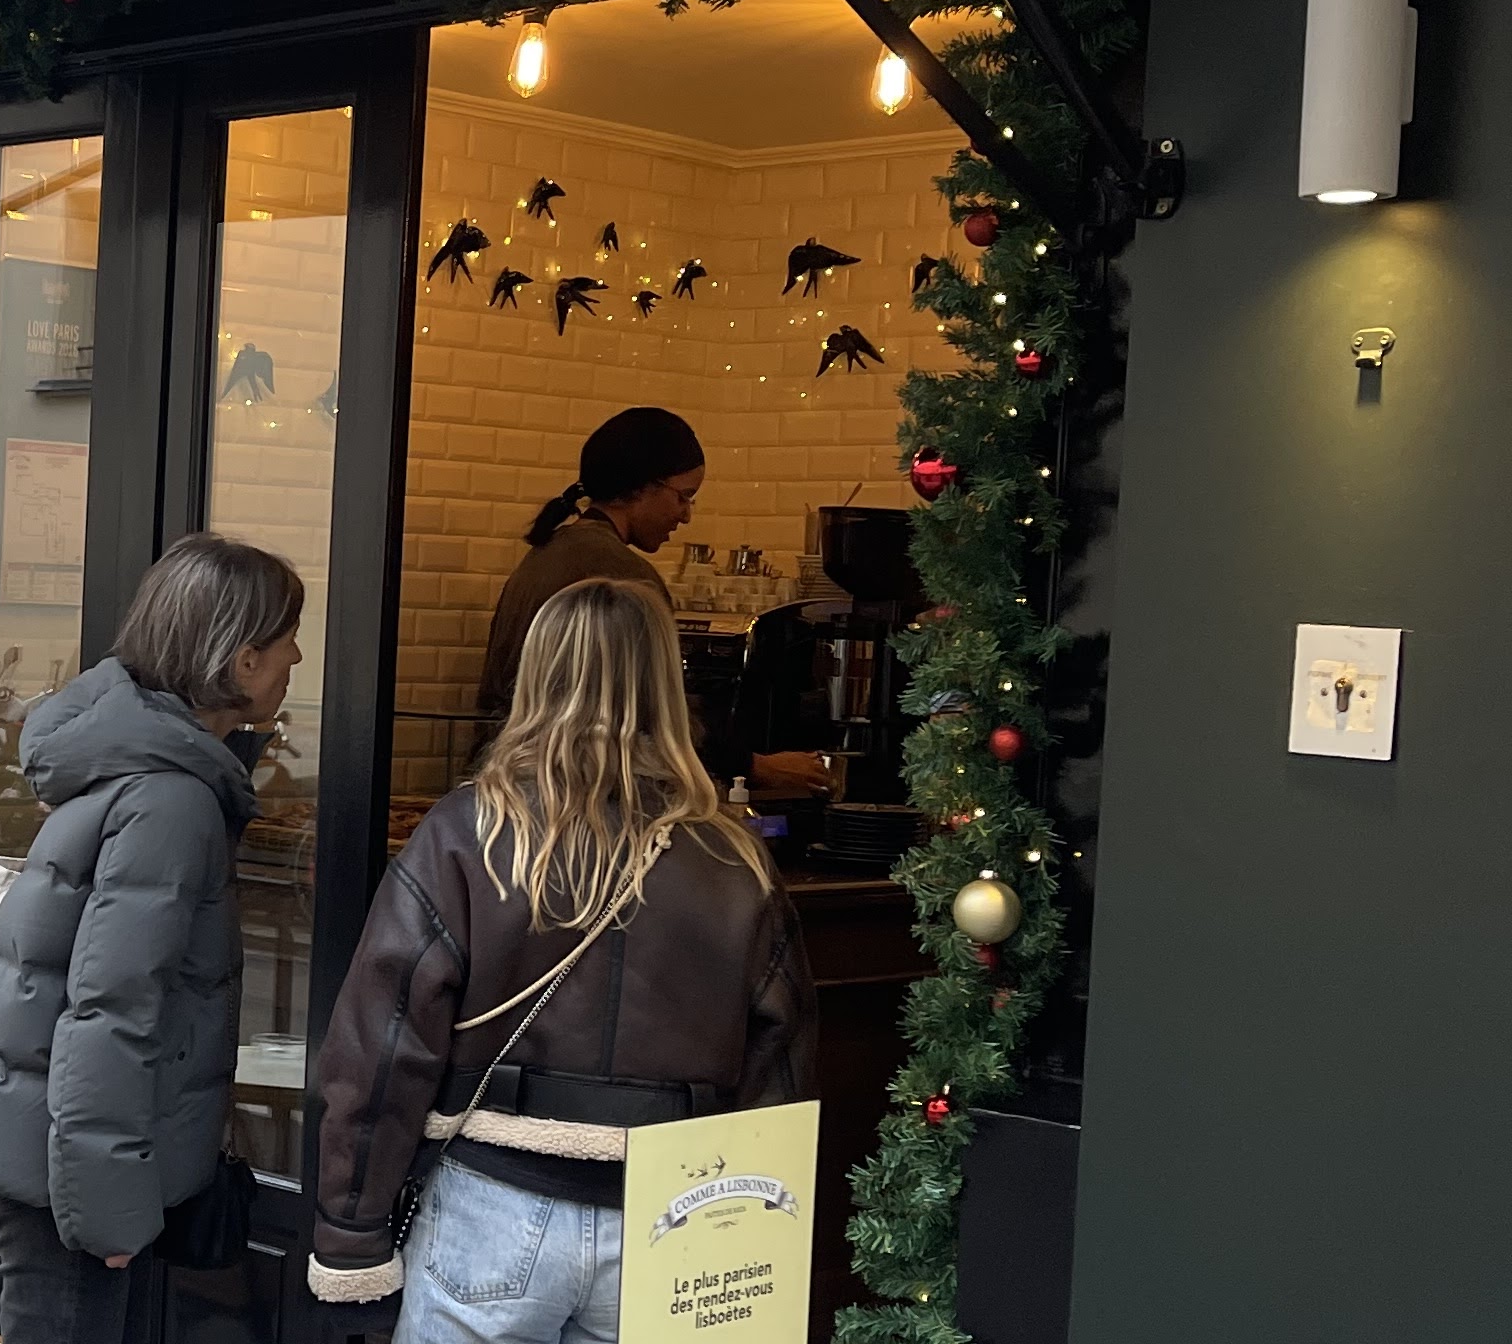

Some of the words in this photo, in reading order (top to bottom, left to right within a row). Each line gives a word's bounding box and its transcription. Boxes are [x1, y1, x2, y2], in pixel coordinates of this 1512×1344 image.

[27, 320, 50, 339] LOVE
[53, 323, 80, 342] PARIS
[674, 1184, 716, 1214] COMME
[717, 1182, 726, 1194] A
[727, 1179, 778, 1195] LISBONNE
[674, 1277, 689, 1294] Le
[693, 1270, 719, 1296] plus
[723, 1261, 772, 1294] parisien
[670, 1296, 694, 1315] des
[697, 1281, 774, 1309] rendez-vous
[695, 1305, 752, 1329] lisboètes
